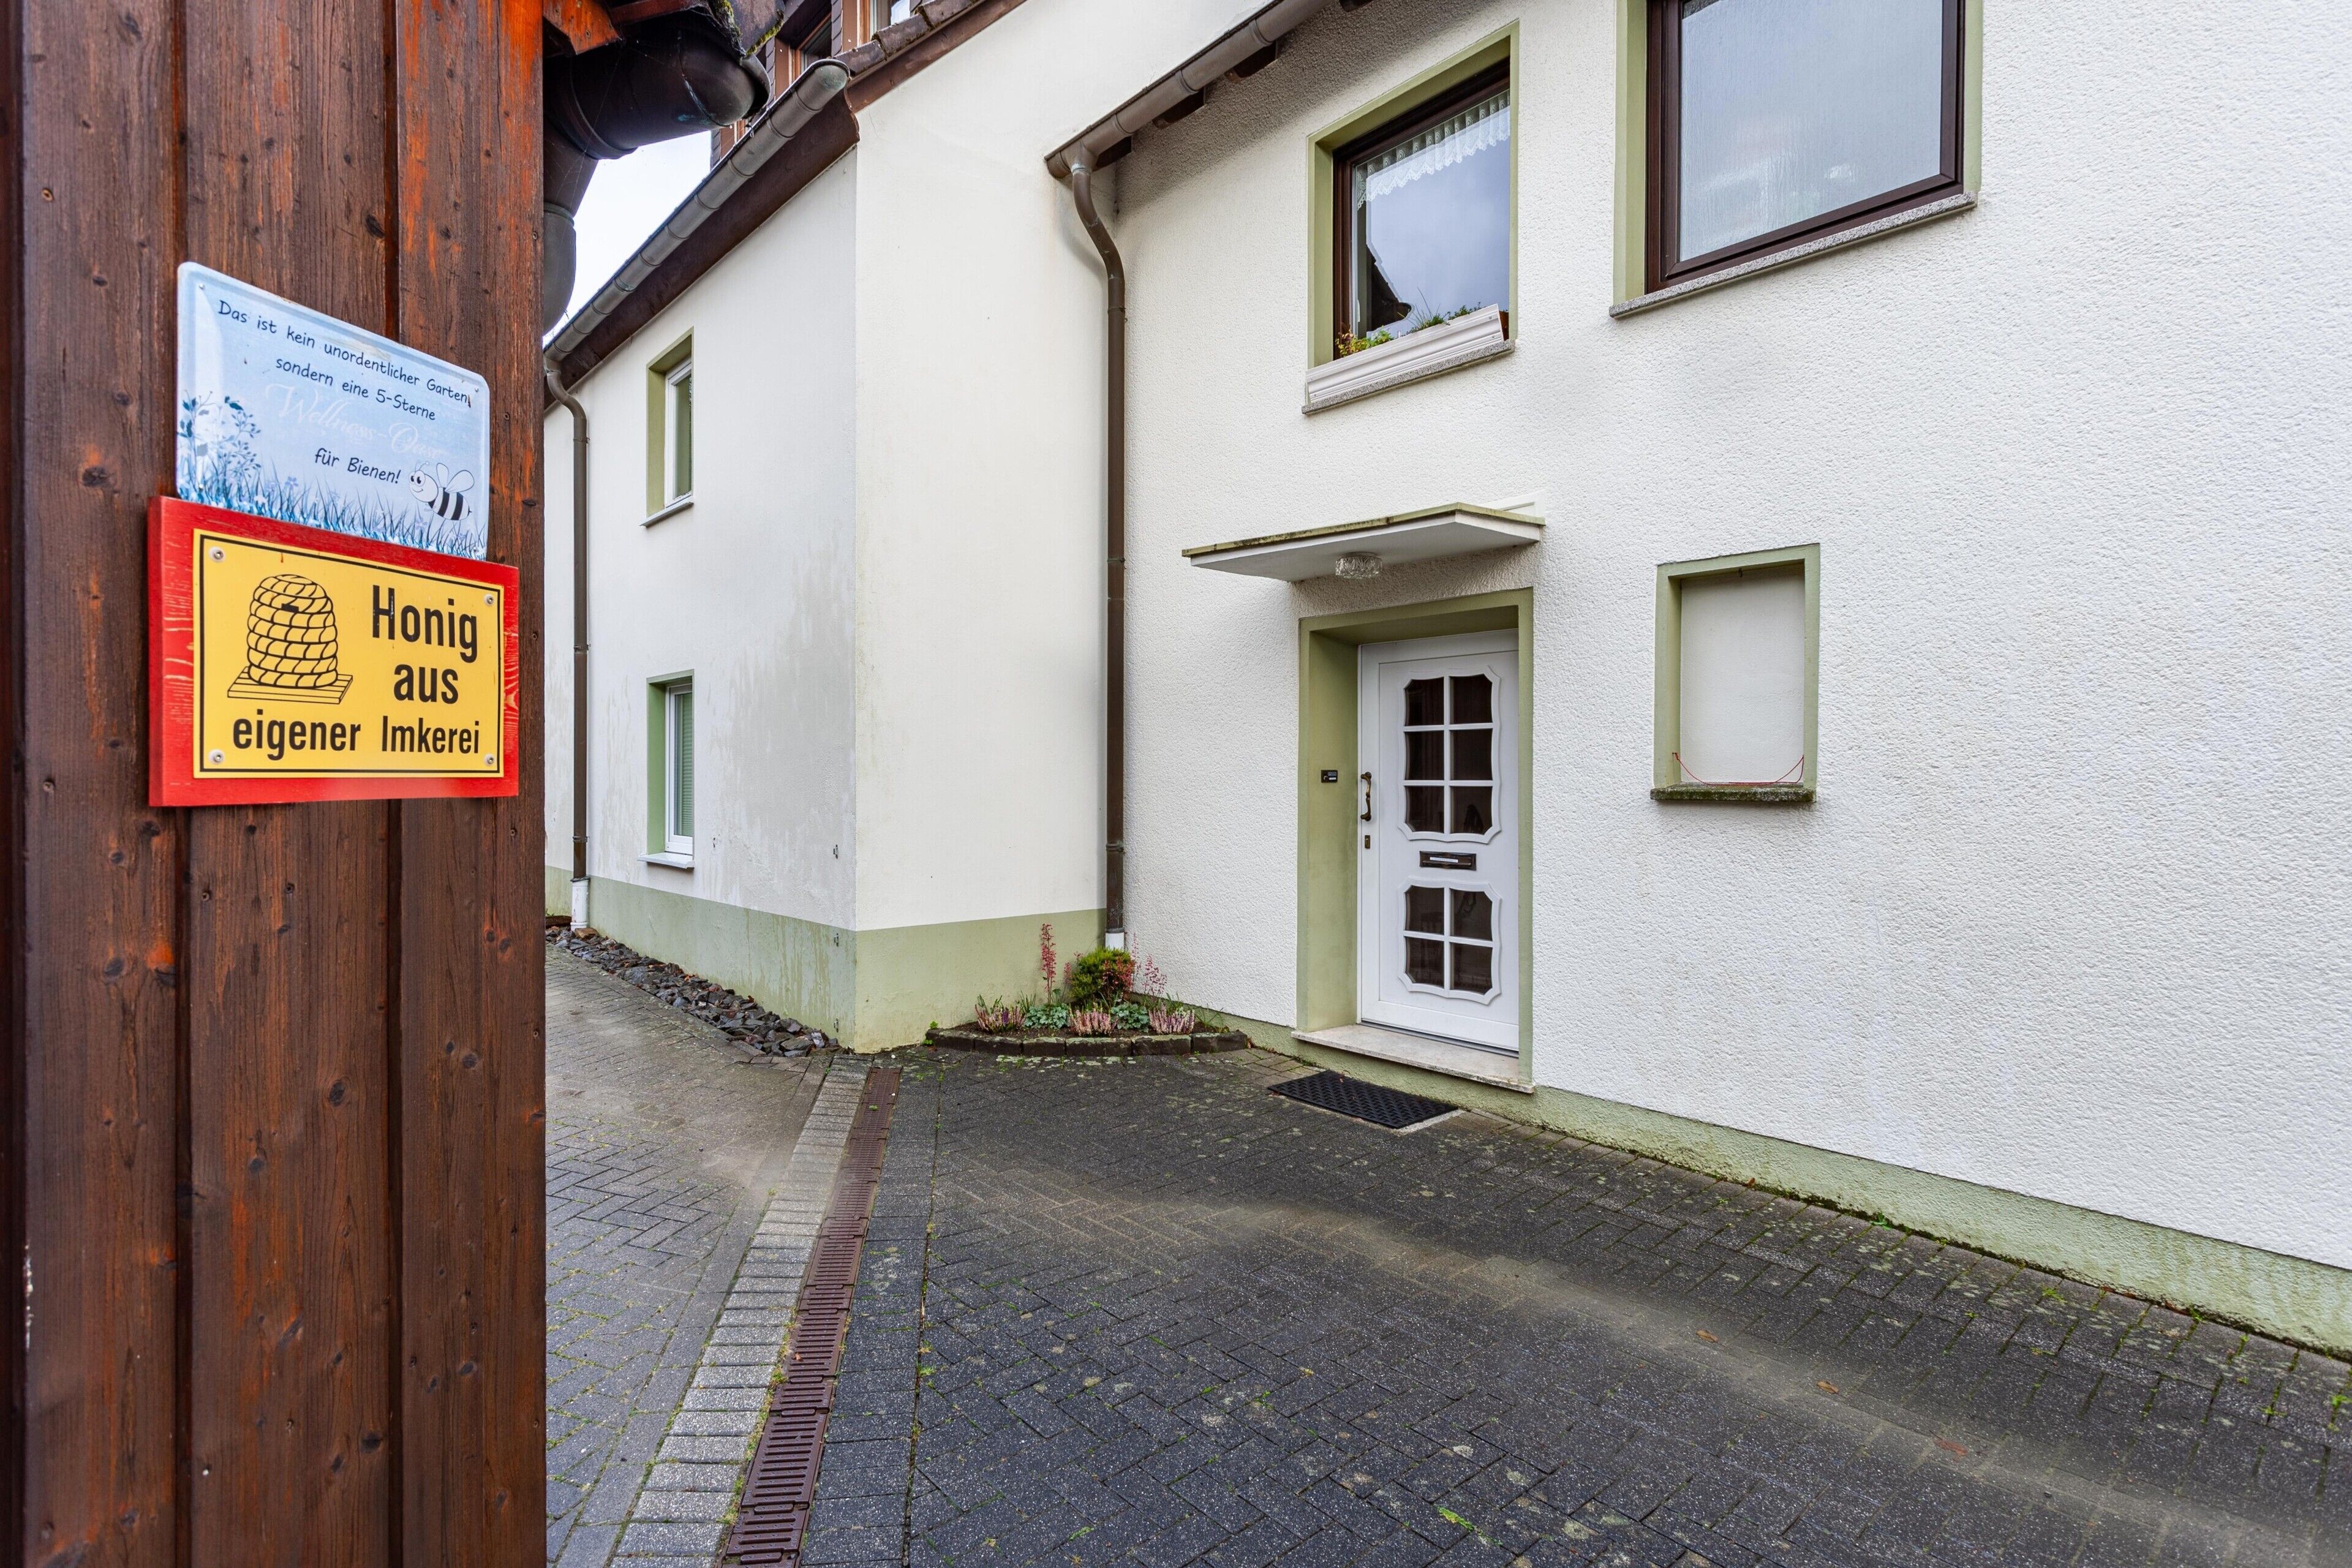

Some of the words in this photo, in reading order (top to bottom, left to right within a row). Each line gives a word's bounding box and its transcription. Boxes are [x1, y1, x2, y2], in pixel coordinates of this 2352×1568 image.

[218, 300, 247, 323] Das
[257, 315, 277, 333] ist
[287, 325, 315, 349] kein
[324, 344, 420, 385] unordentlicher
[276, 358, 334, 386] sondern
[342, 380, 369, 398] eine
[375, 389, 435, 420] 5-Sterne
[315, 448, 339, 467] für
[347, 458, 401, 484] Bienen!
[372, 584, 478, 663] Honig
[394, 664, 459, 704] aus
[233, 709, 361, 761] eigener
[382, 715, 480, 754] Imkerei
